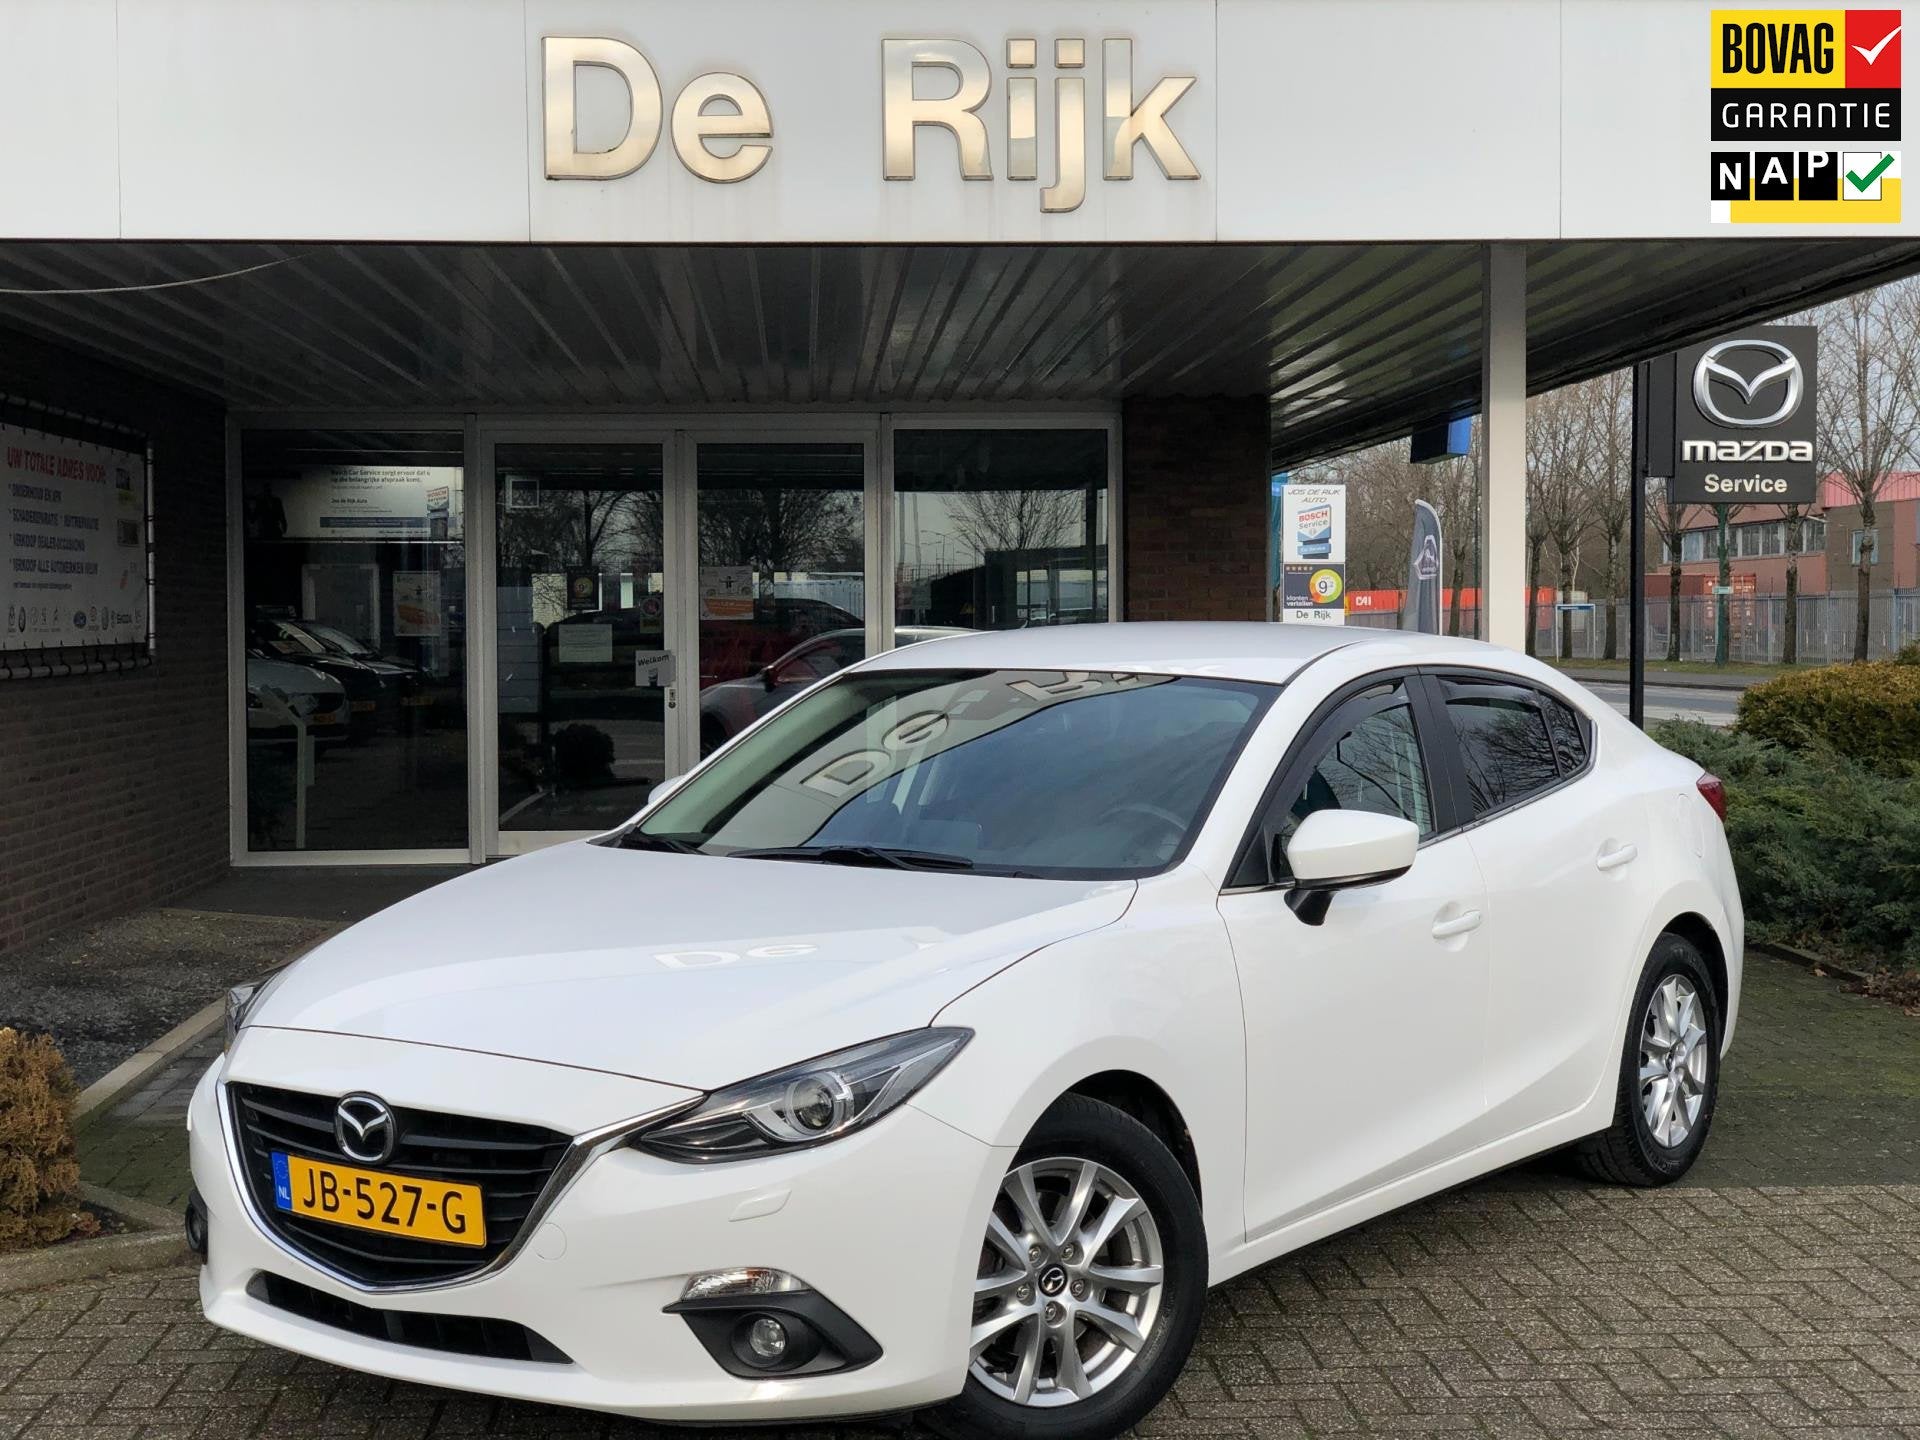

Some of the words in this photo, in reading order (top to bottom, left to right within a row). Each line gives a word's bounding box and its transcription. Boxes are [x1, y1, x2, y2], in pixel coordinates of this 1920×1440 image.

[542, 35, 774, 184] De
[881, 38, 1202, 213] Rijk
[1704, 473, 1788, 493] Service
[1287, 488, 1306, 496] JOS
[1306, 488, 1320, 496] DE
[1298, 510, 1328, 522] BOSCH
[1298, 519, 1328, 530] Service
[1296, 610, 1309, 619] De
[1313, 610, 1331, 621] Rijk
[638, 654, 670, 667] Welkom
[278, 1185, 290, 1201] NL
[303, 1167, 467, 1235] JB-527-G
